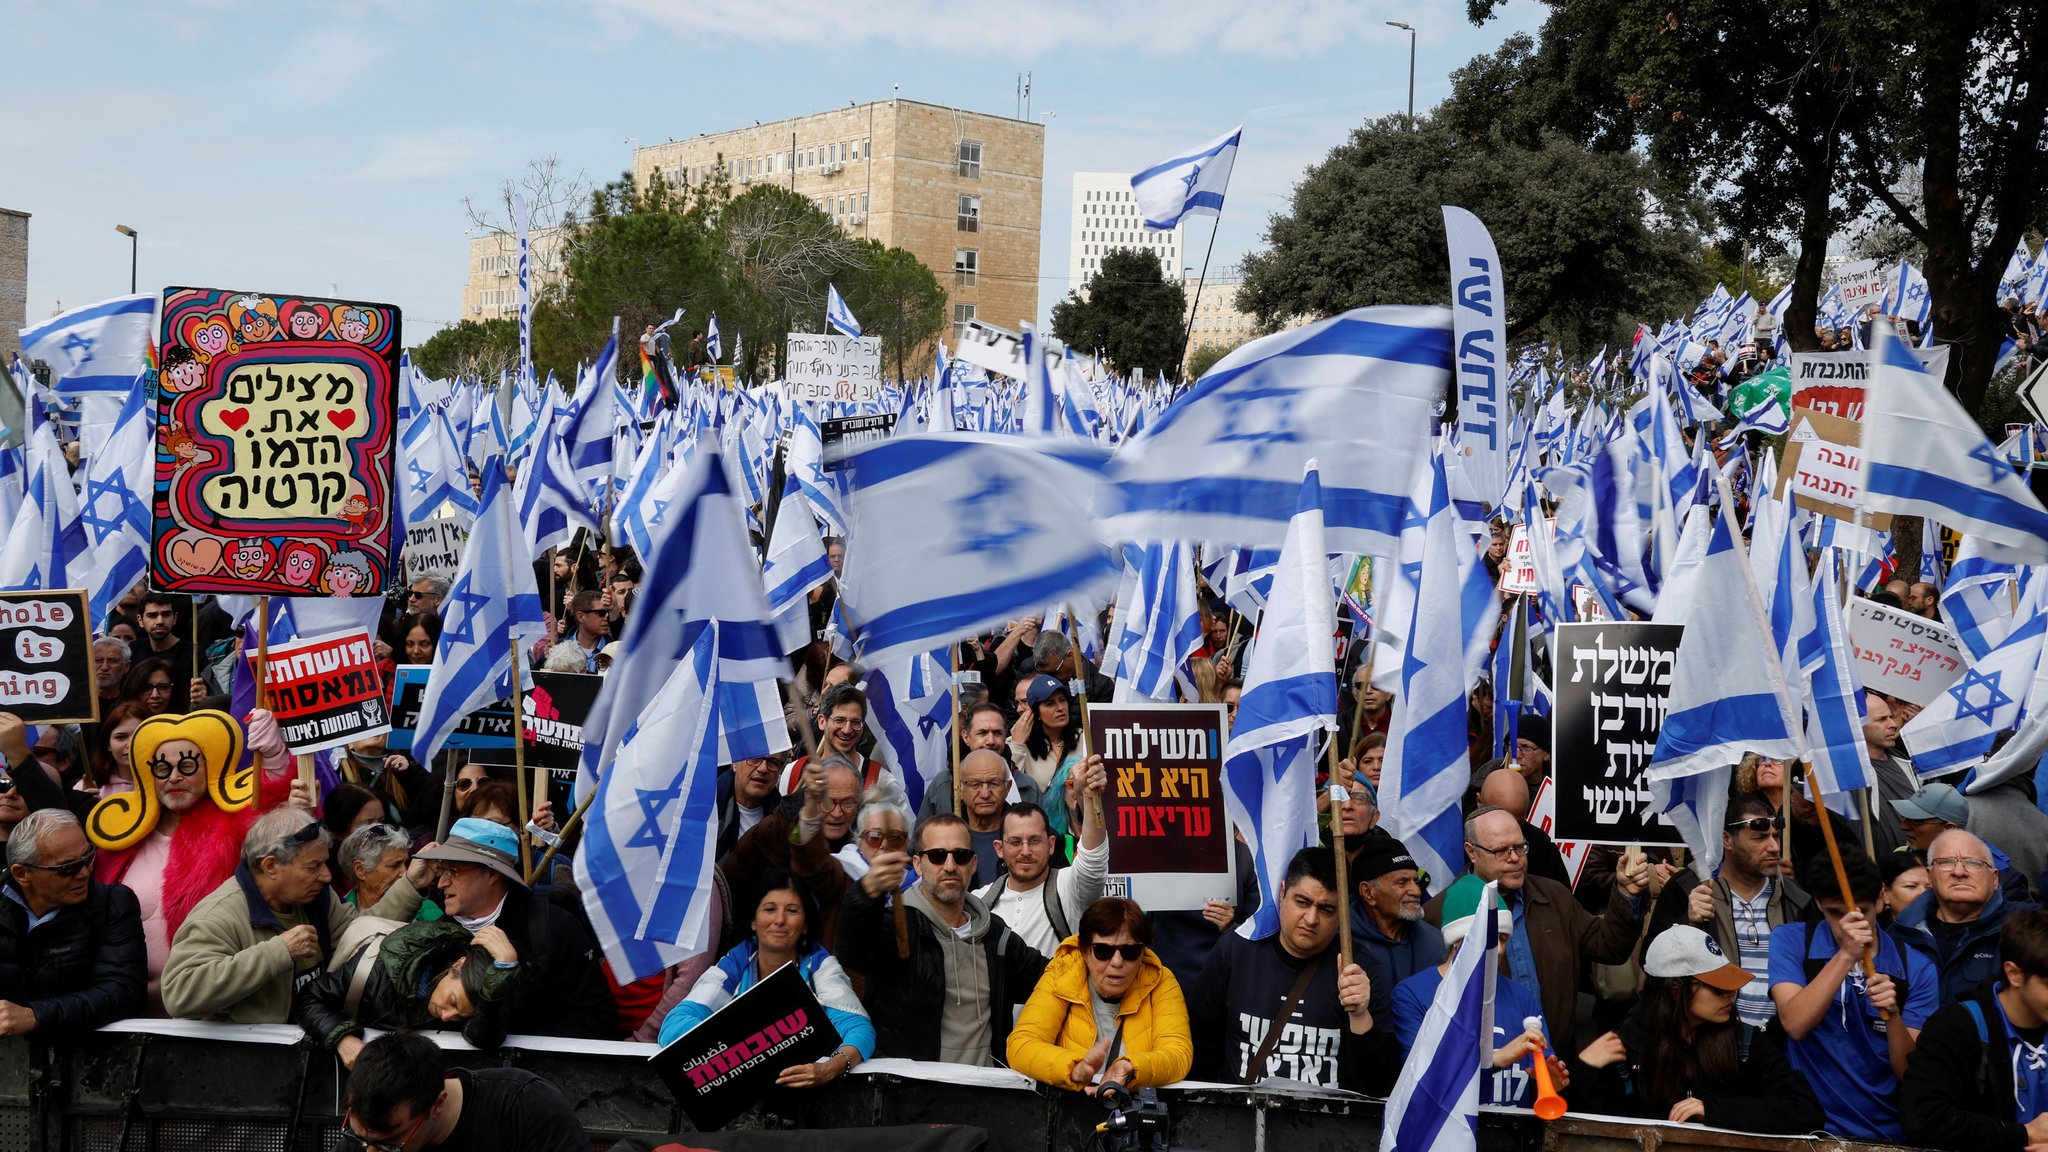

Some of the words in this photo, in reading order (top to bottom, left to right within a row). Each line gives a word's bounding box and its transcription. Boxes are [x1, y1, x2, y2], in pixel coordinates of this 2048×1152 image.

[229, 366, 354, 404] מצילים
[834, 380, 857, 402] גדול
[260, 409, 320, 433] את
[219, 471, 347, 515] קרטיה
[441, 522, 461, 552] אין
[22, 637, 52, 658] is
[1570, 632, 1681, 686] משלת
[1890, 638, 1960, 672] היקיצה
[320, 710, 362, 736] התנועה
[477, 716, 512, 734] אין
[536, 734, 560, 746] הנשים
[1117, 762, 1152, 798] לא
[1160, 767, 1209, 798] היא
[1117, 805, 1211, 837] עריצות
[766, 1035, 799, 1057] תפגעו
[799, 1025, 815, 1039] לא
[685, 1008, 808, 1090] שובתות
[728, 1053, 767, 1079] בזכויות
[1239, 1041, 1340, 1089] בארצו
[697, 1075, 728, 1096] נשים!
